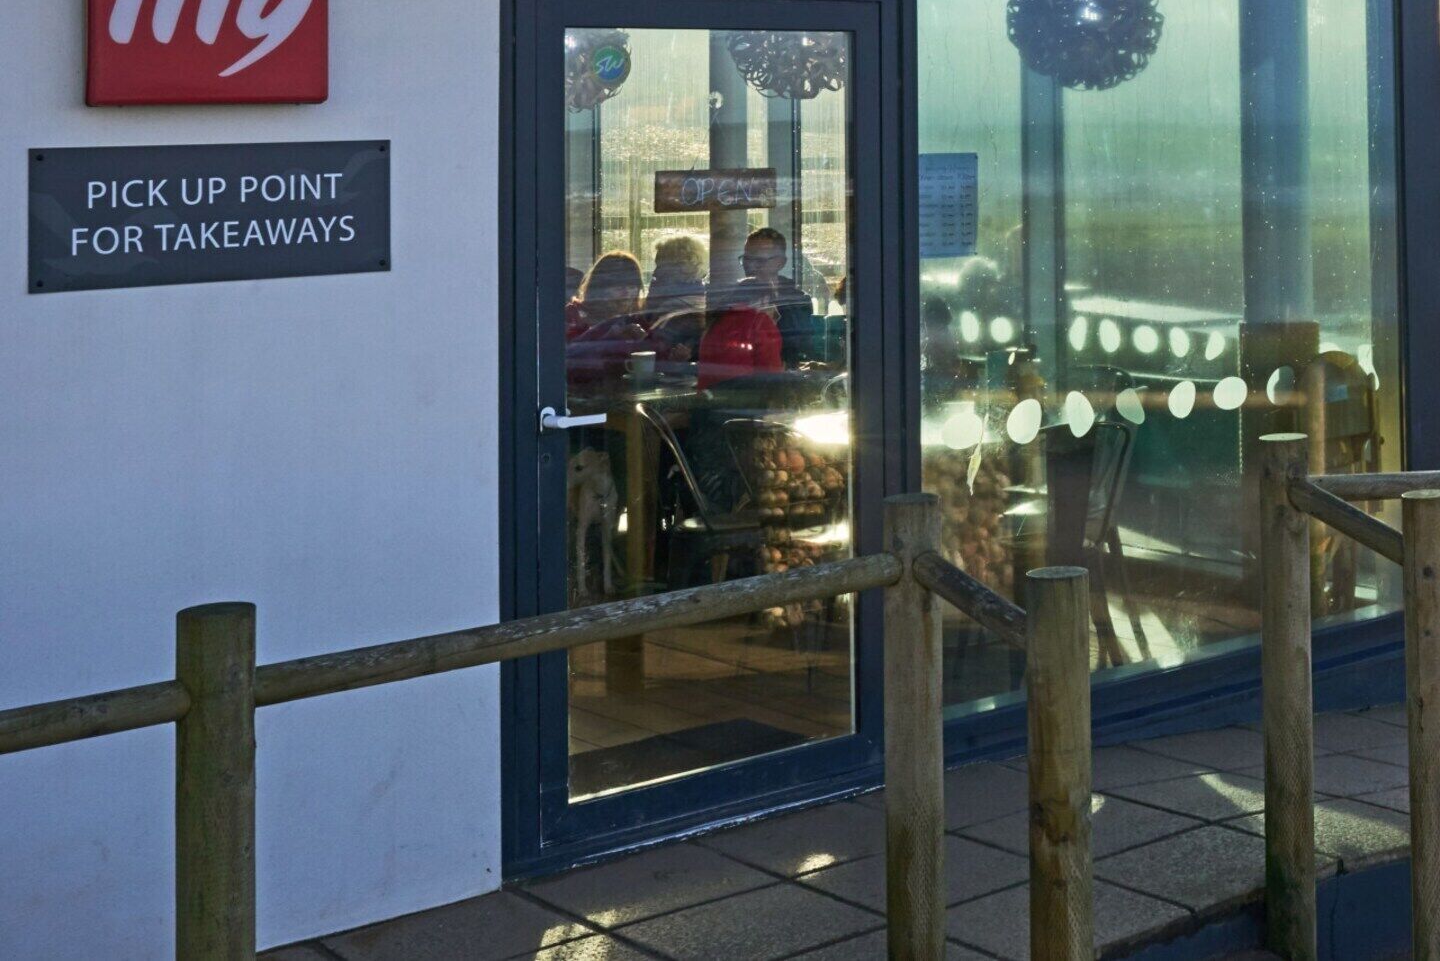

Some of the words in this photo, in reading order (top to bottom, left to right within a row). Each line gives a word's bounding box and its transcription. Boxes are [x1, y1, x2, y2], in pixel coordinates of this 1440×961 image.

[87, 179, 168, 209] PICK
[181, 176, 227, 206] UP
[240, 172, 343, 204] POINT
[71, 226, 144, 256] FOR
[155, 215, 355, 251] TAKEAWAYS
